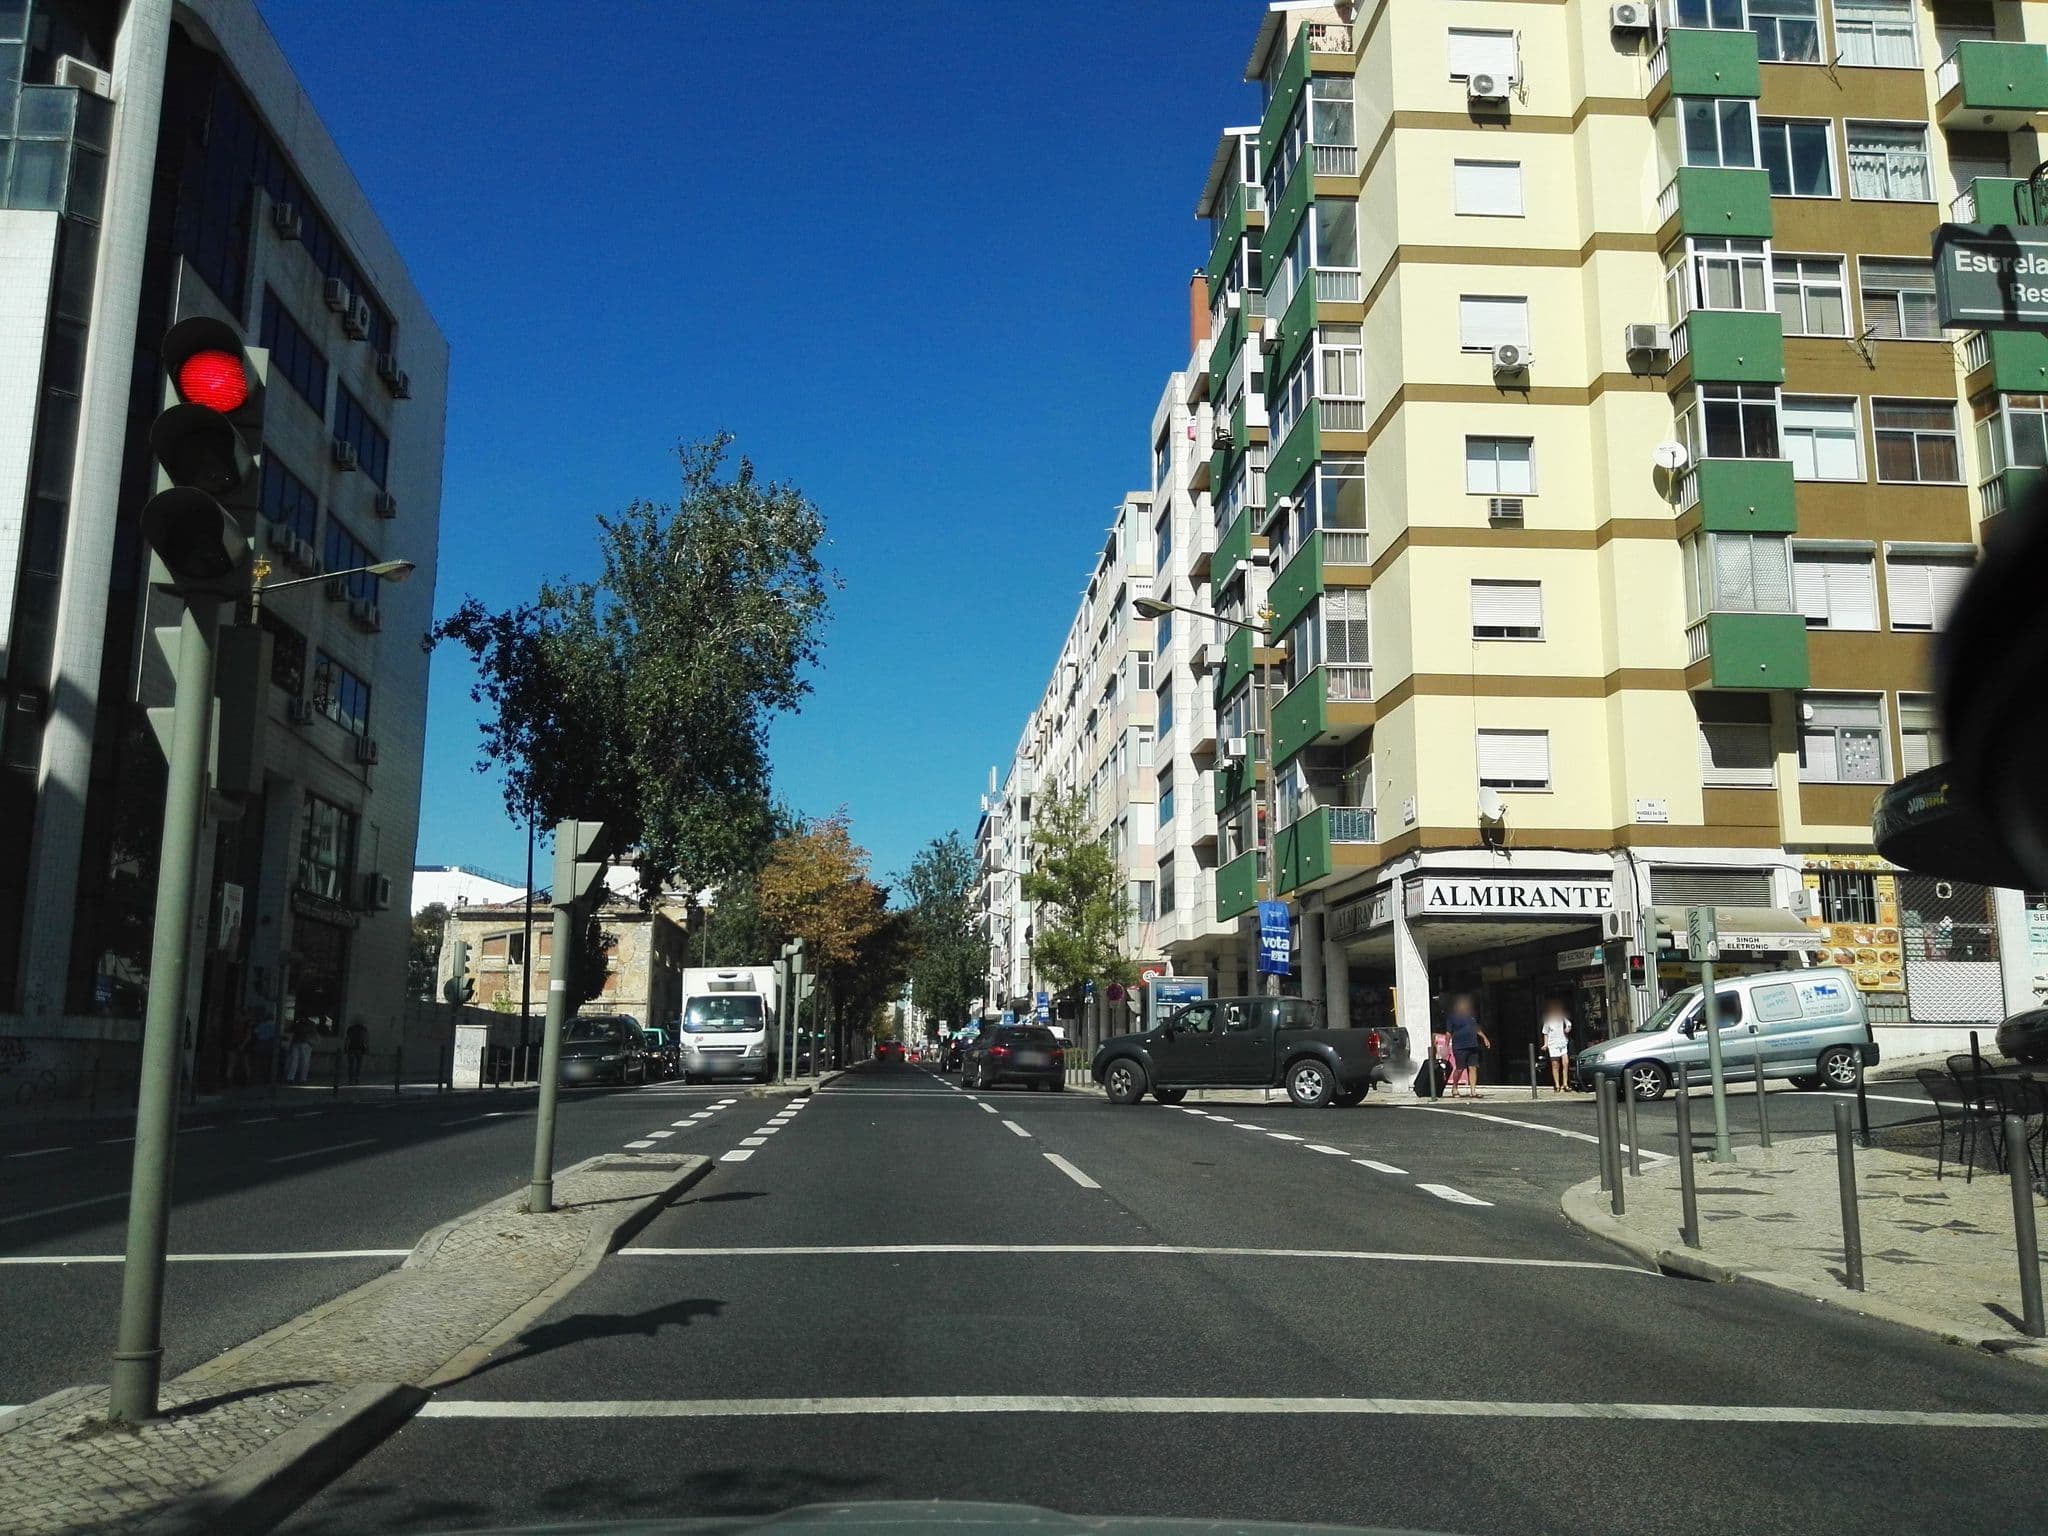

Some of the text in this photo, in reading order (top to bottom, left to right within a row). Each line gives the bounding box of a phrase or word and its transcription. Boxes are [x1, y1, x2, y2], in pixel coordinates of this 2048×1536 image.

[1955, 250, 2048, 275] Estrela
[1429, 885, 1613, 908] ALMIRANTE
[1262, 936, 1290, 950] vota
